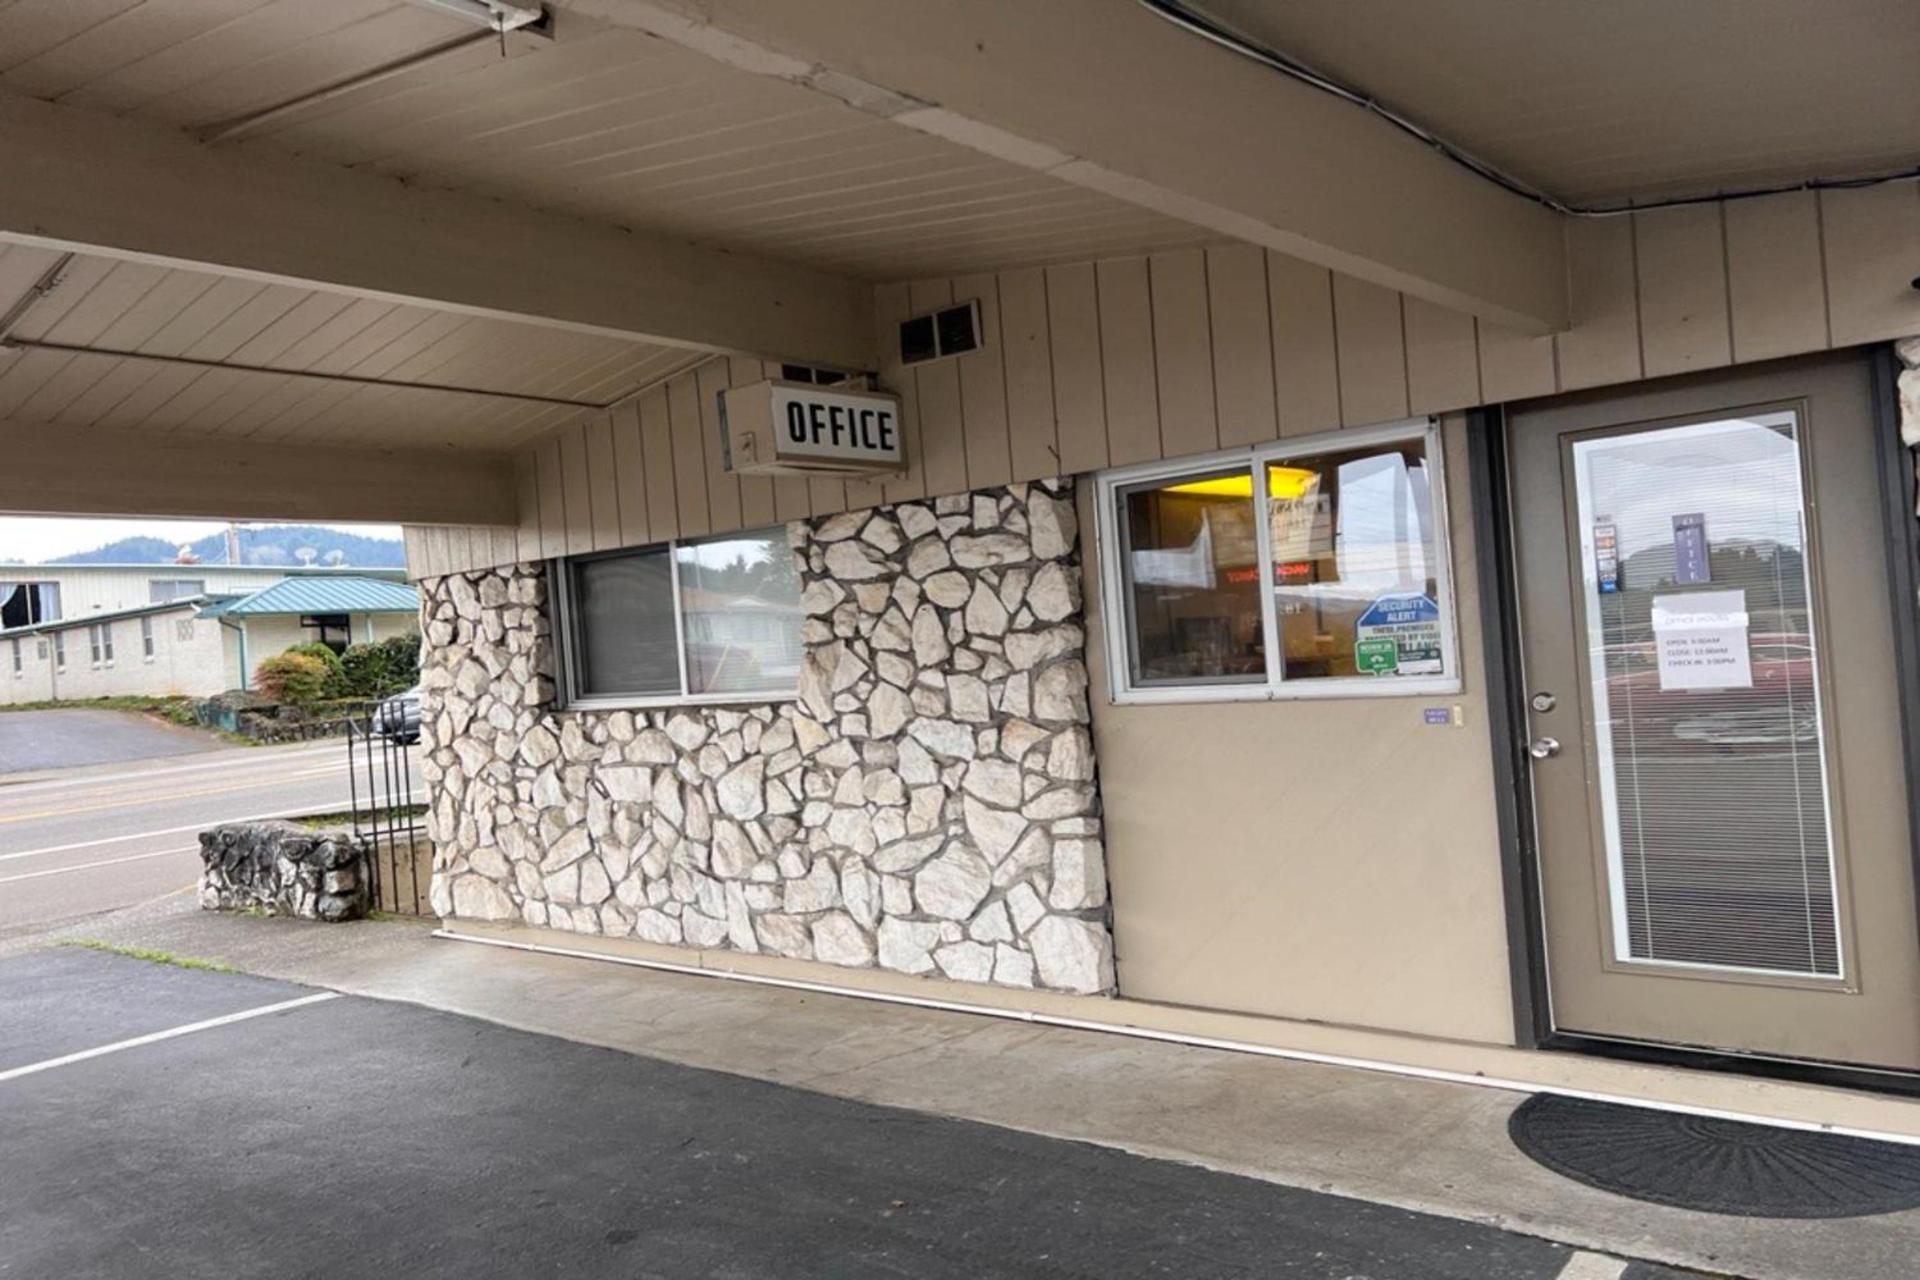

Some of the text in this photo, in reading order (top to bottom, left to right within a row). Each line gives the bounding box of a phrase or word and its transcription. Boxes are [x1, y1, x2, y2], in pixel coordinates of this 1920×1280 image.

[787, 401, 895, 451] OFFICE
[1681, 517, 1700, 581] OFFICE
[1377, 600, 1425, 612] SECURITY
[1386, 611, 1417, 622] ALERT
